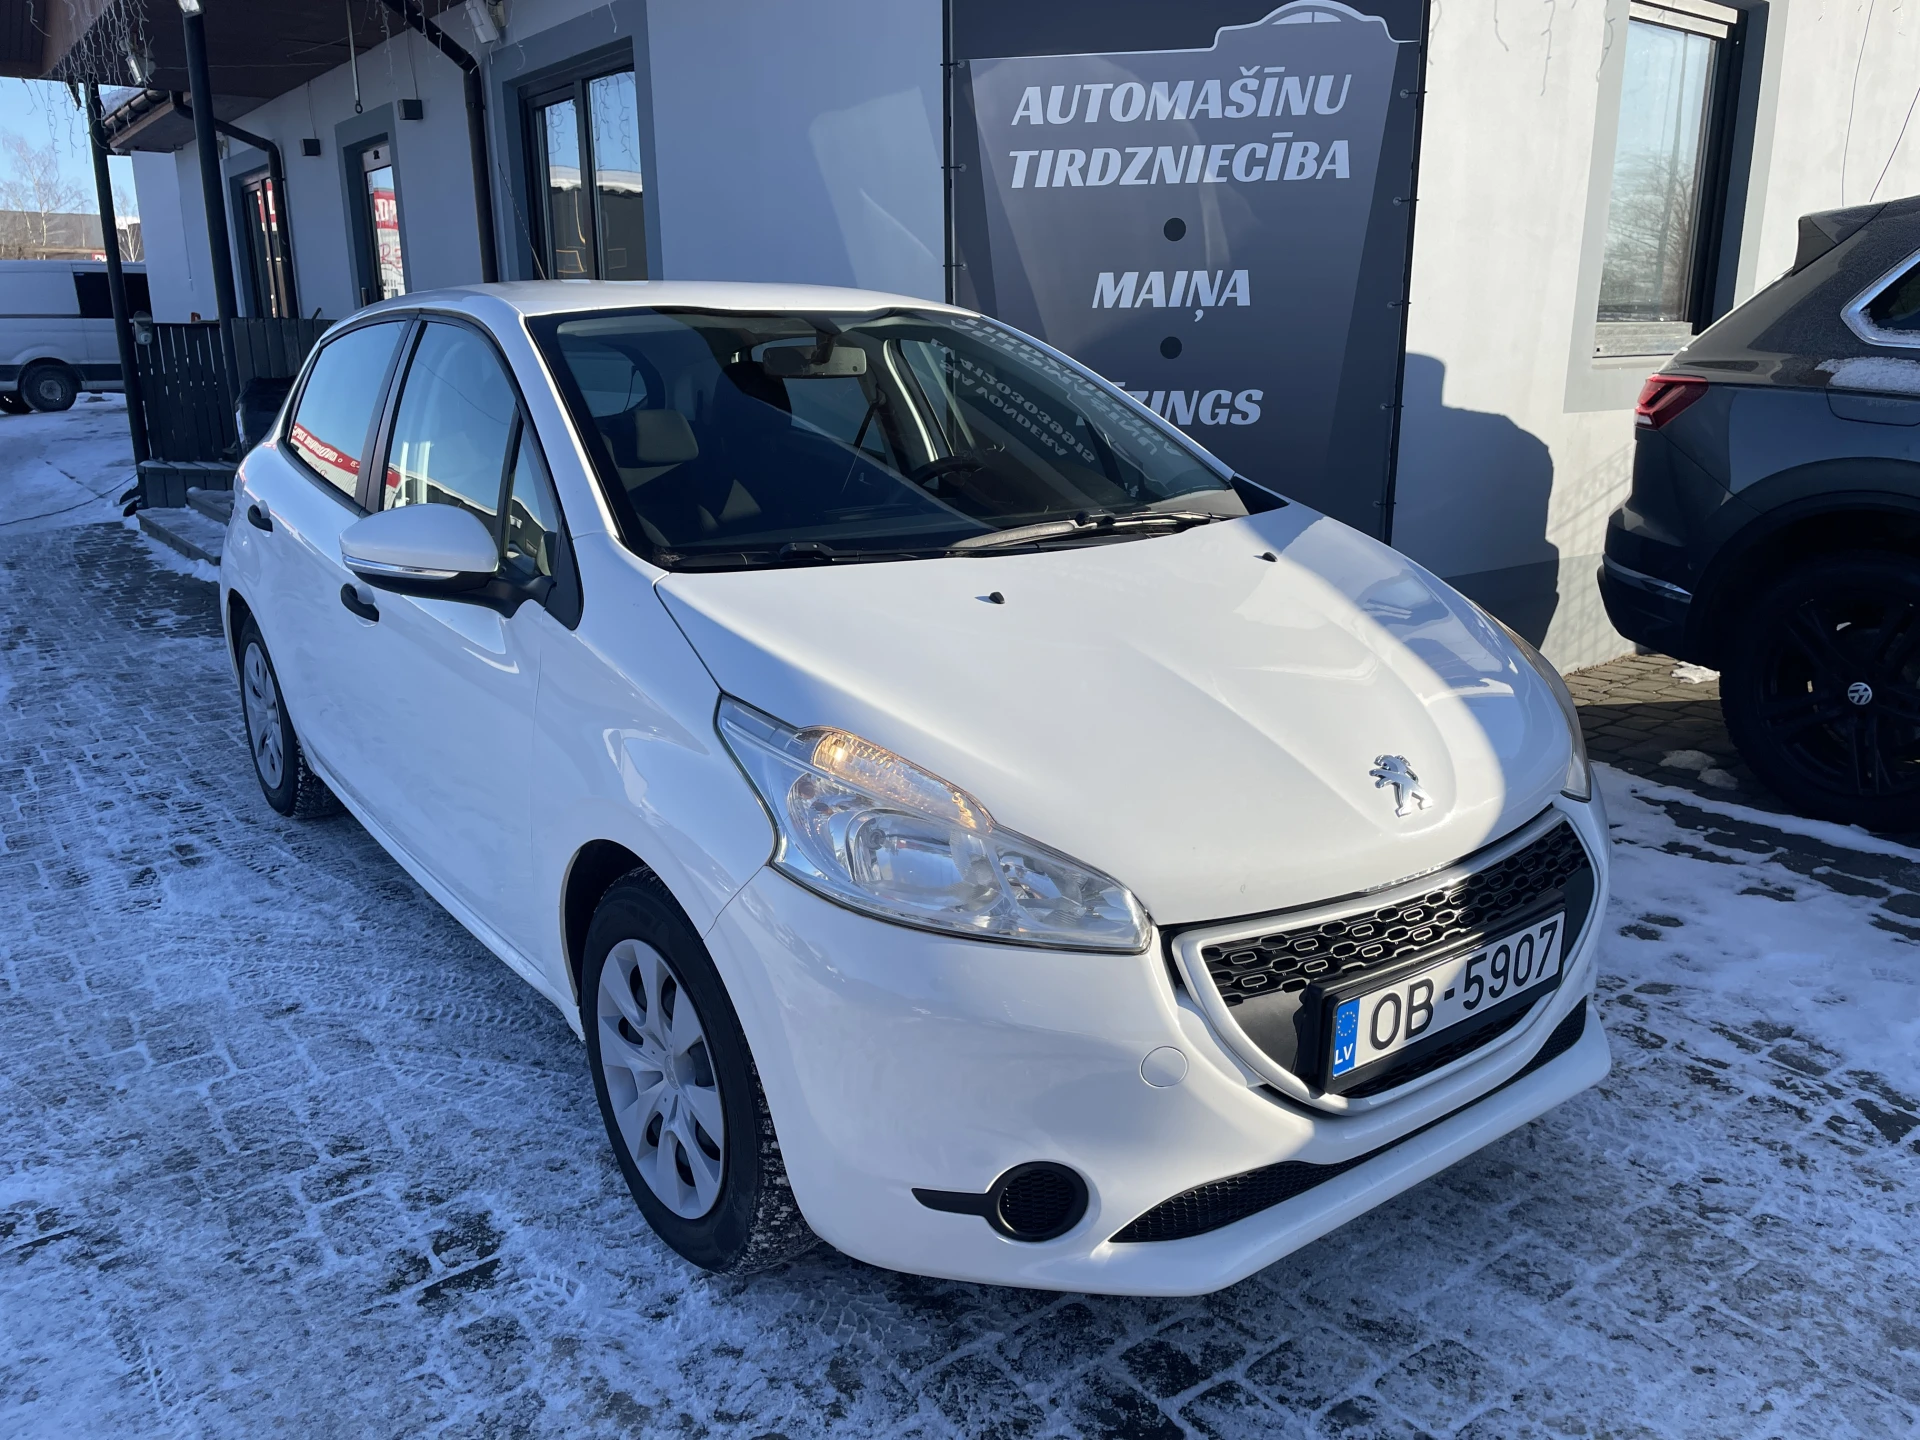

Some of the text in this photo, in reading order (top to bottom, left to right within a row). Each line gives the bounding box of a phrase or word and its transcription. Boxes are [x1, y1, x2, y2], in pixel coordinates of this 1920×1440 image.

[1010, 65, 1352, 126] AUTOMAŠĪNU
[1008, 131, 1350, 189] TIRDZNIECĪBA
[1091, 269, 1251, 322] MAIŅA
[1369, 919, 1559, 1051] OB-5907
[1333, 1042, 1354, 1066] LV
